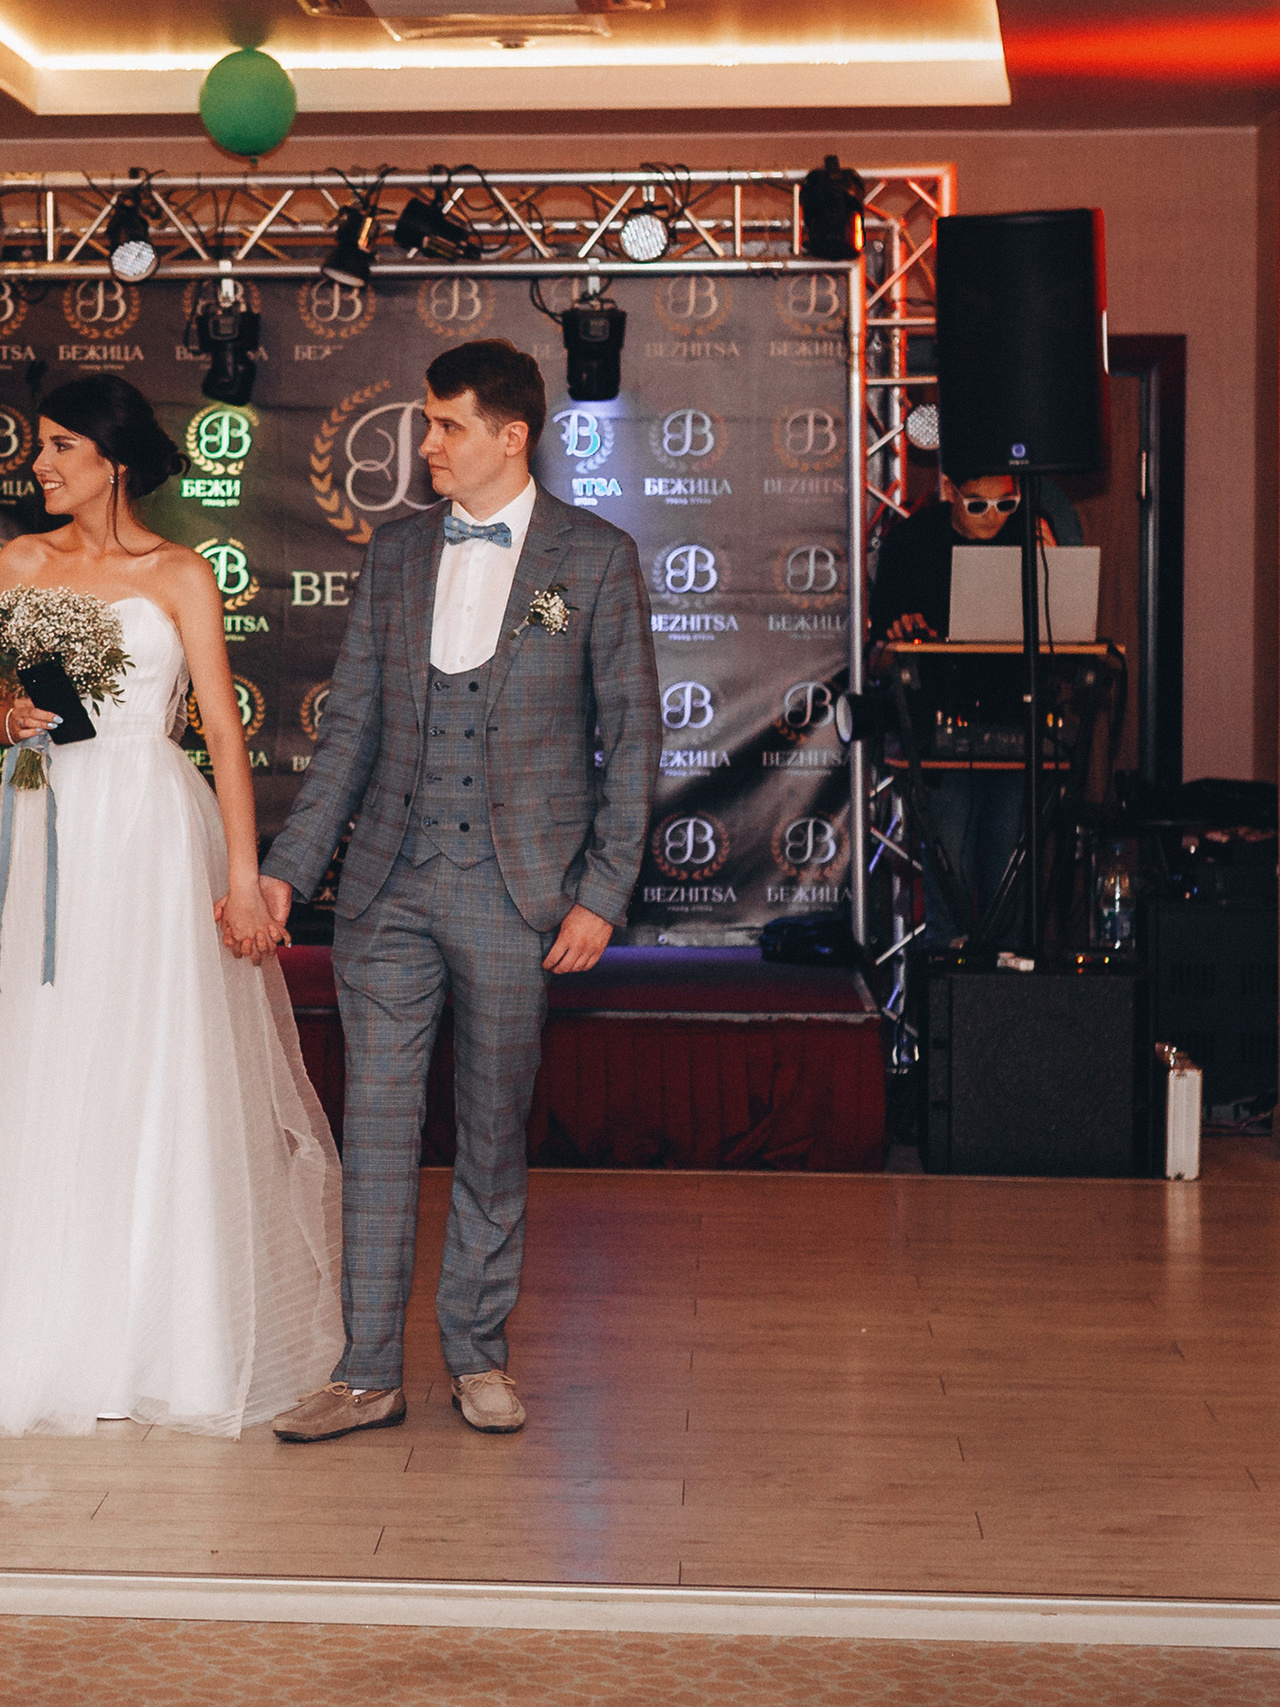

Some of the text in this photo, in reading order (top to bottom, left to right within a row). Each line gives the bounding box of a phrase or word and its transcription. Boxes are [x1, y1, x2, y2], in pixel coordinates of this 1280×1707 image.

[58, 345, 145, 361] БЕЖИЦА
[643, 477, 733, 496] БЕЖИЦА
[651, 614, 740, 632] BEZHITSA
[768, 614, 847, 632] БЕЖИЦ
[762, 751, 848, 767] BEZHITS
[643, 886, 737, 903] BEZHITSA
